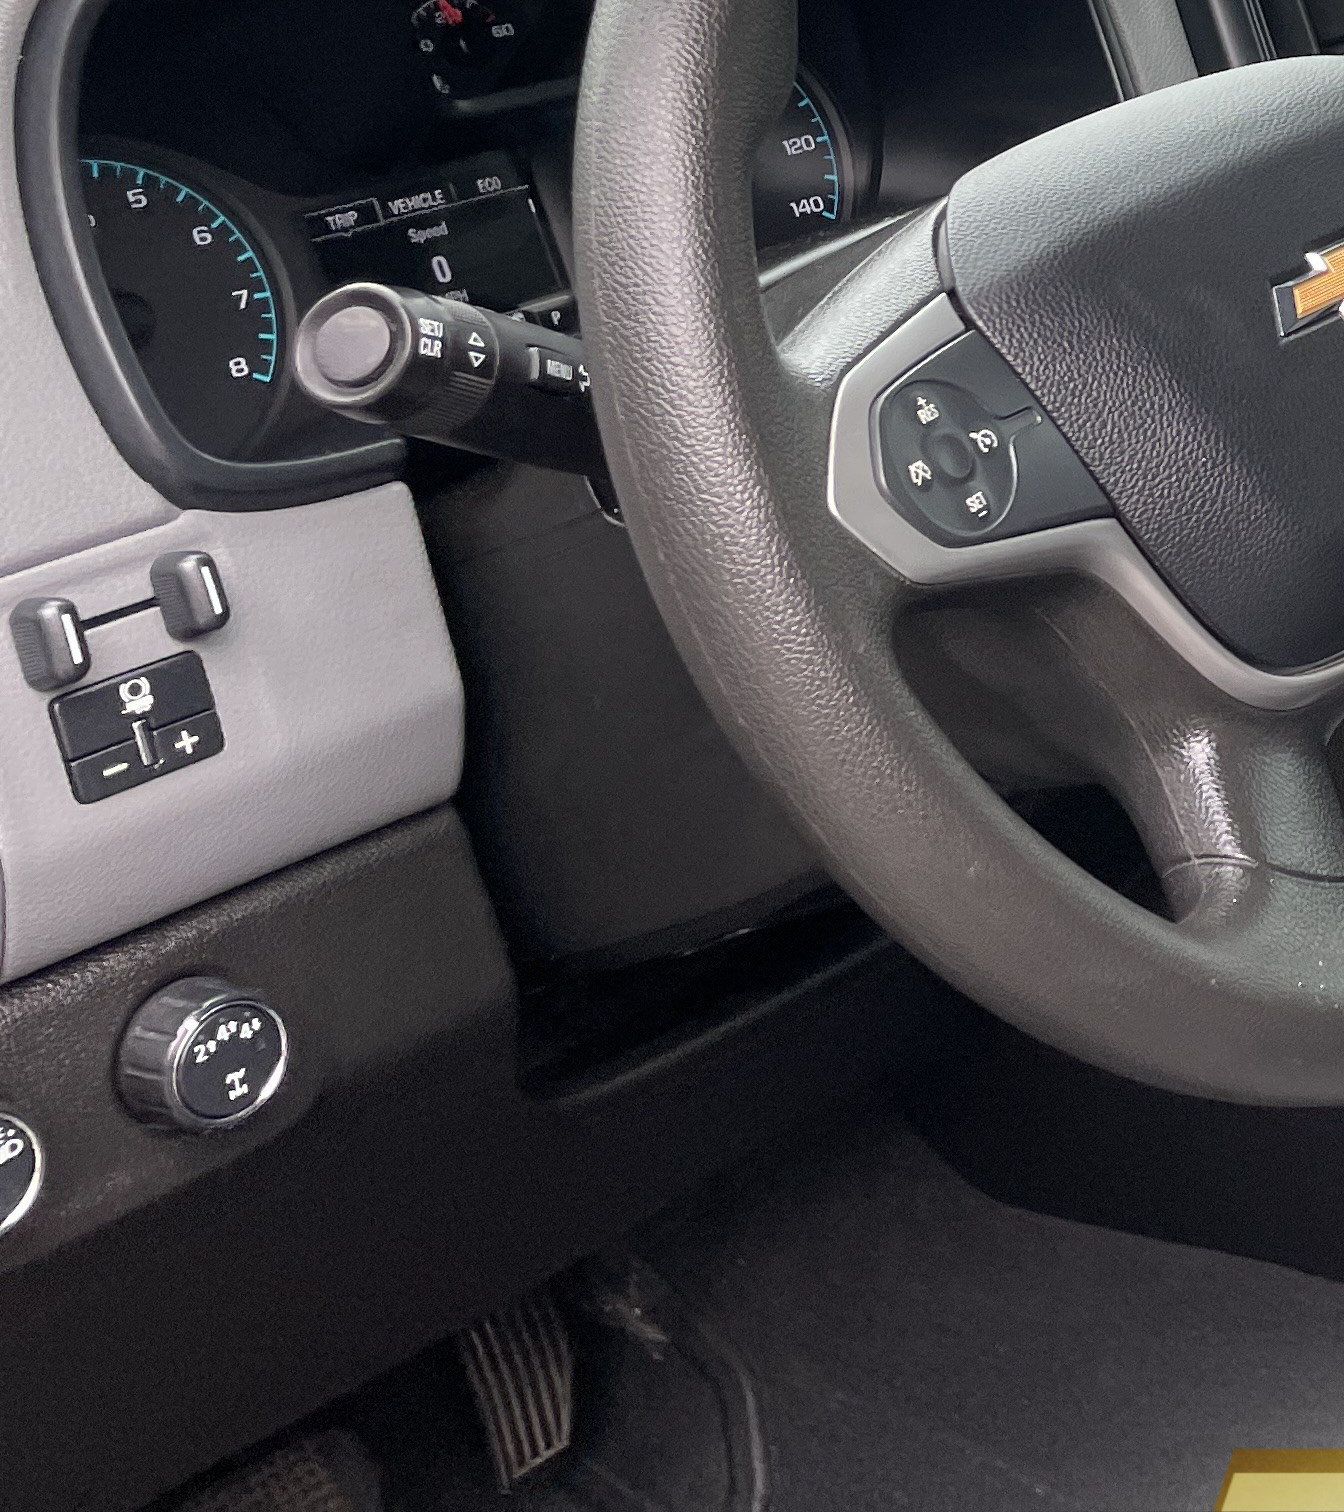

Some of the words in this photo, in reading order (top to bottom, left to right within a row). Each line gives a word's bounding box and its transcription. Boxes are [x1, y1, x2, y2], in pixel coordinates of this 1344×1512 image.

[782, 134, 816, 156] 120
[126, 188, 148, 209] 5
[325, 211, 358, 231] TRIP
[387, 190, 446, 216] VEHICLE
[476, 176, 502, 193] ECO
[789, 195, 825, 218] 140
[192, 226, 213, 246] 6
[407, 221, 449, 243] Speed
[431, 255, 452, 284] 0
[231, 289, 248, 310] 7
[419, 338, 442, 358] CLR
[228, 357, 249, 378] 8
